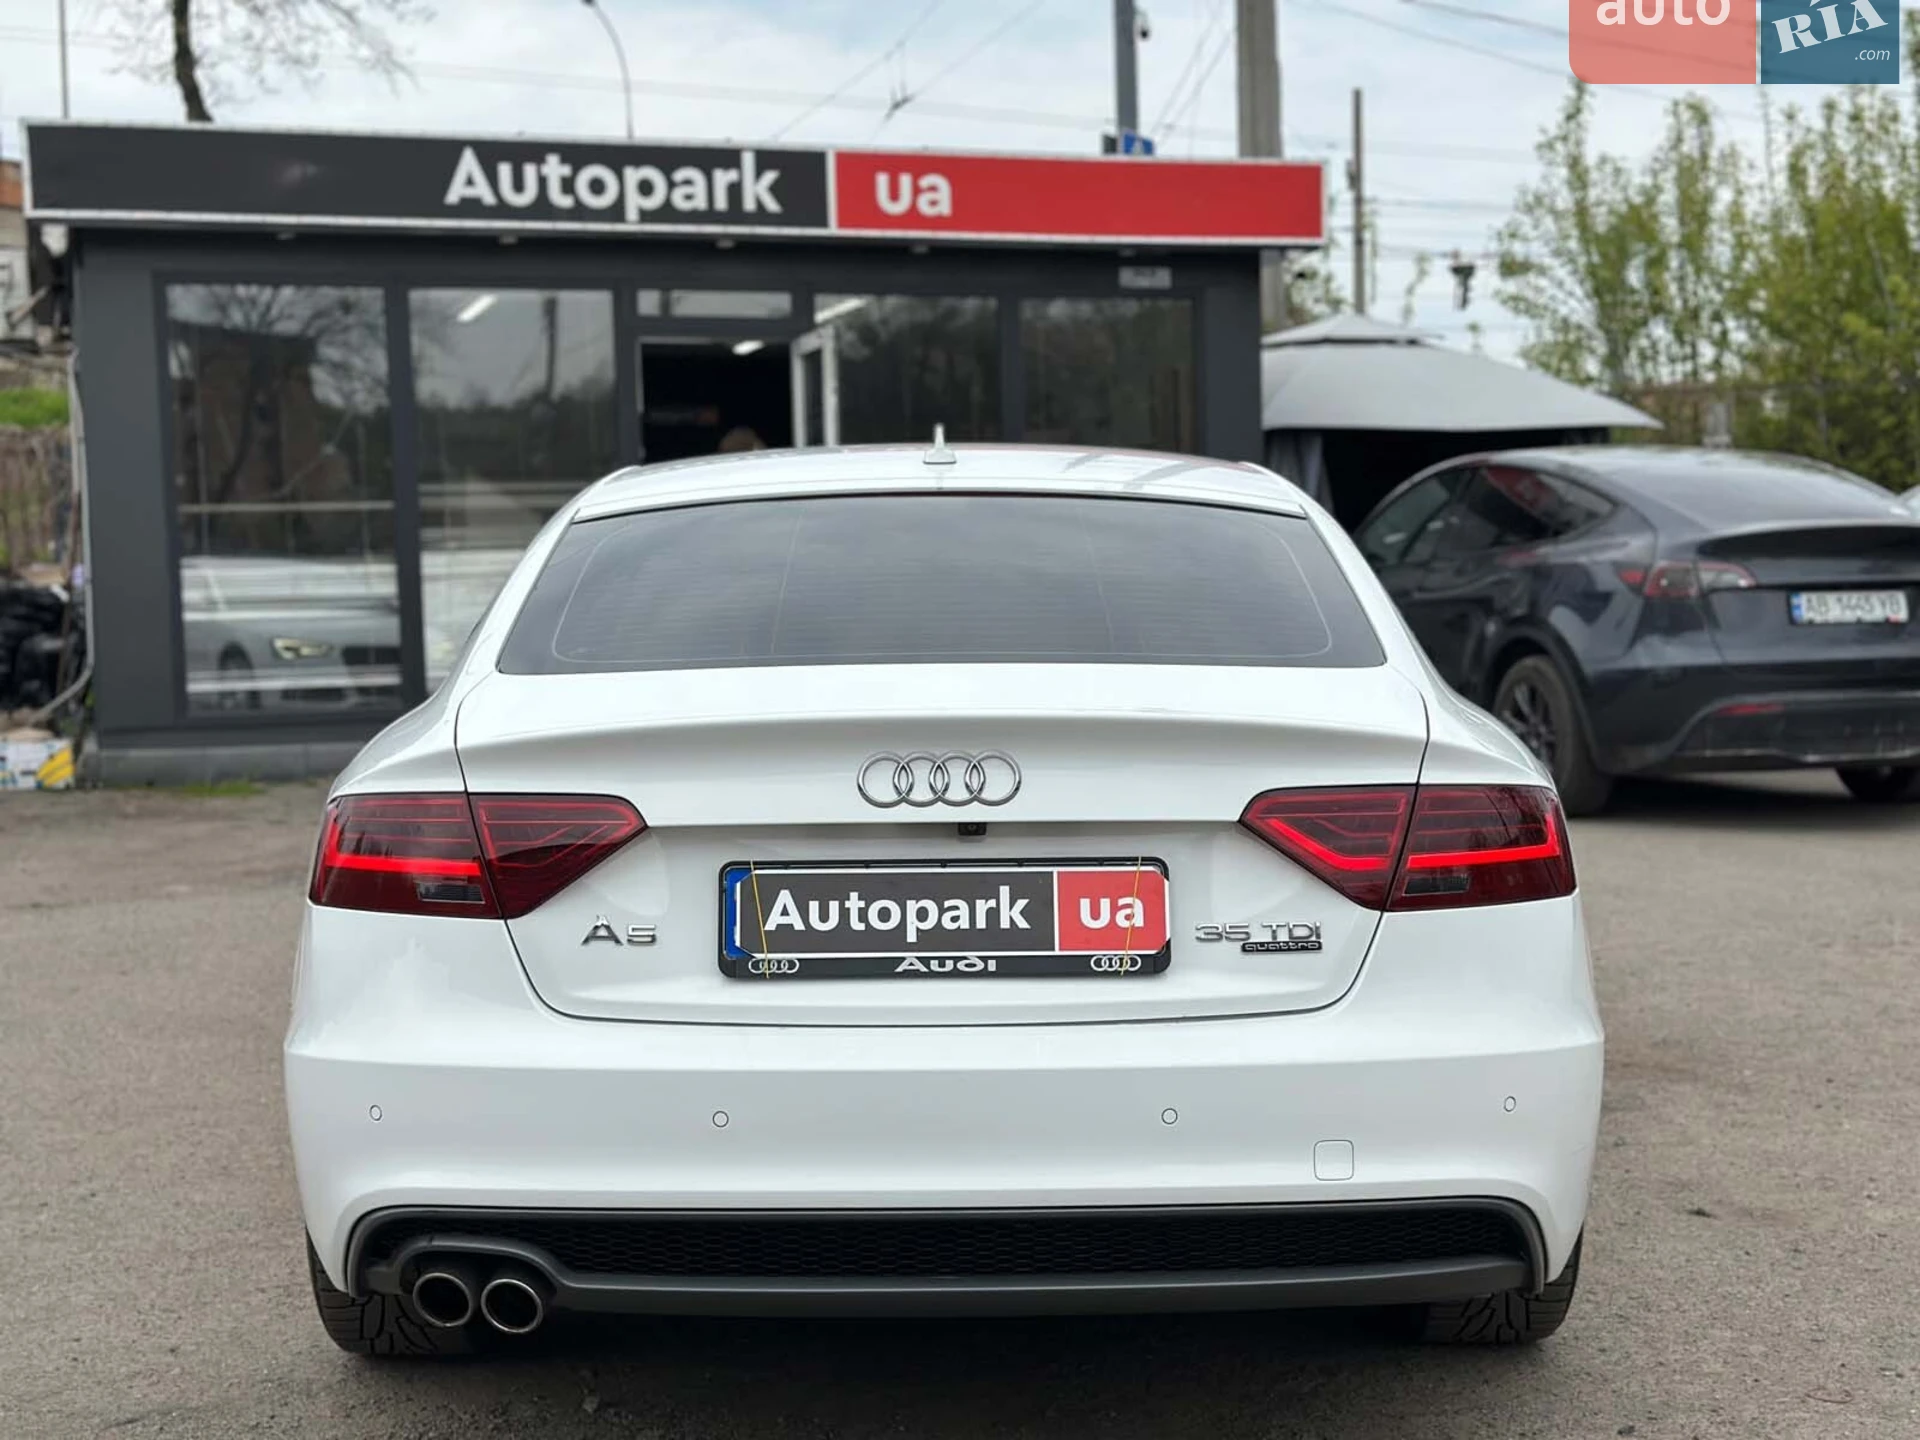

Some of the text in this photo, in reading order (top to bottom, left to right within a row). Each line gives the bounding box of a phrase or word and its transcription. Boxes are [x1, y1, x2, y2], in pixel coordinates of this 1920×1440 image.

[444, 146, 953, 222] Autopark ua
[764, 886, 1145, 943] Autopark ua
[581, 914, 657, 948] A5
[1195, 922, 1251, 942] 35
[1244, 942, 1319, 951] quattro
[894, 956, 997, 973] Audi
